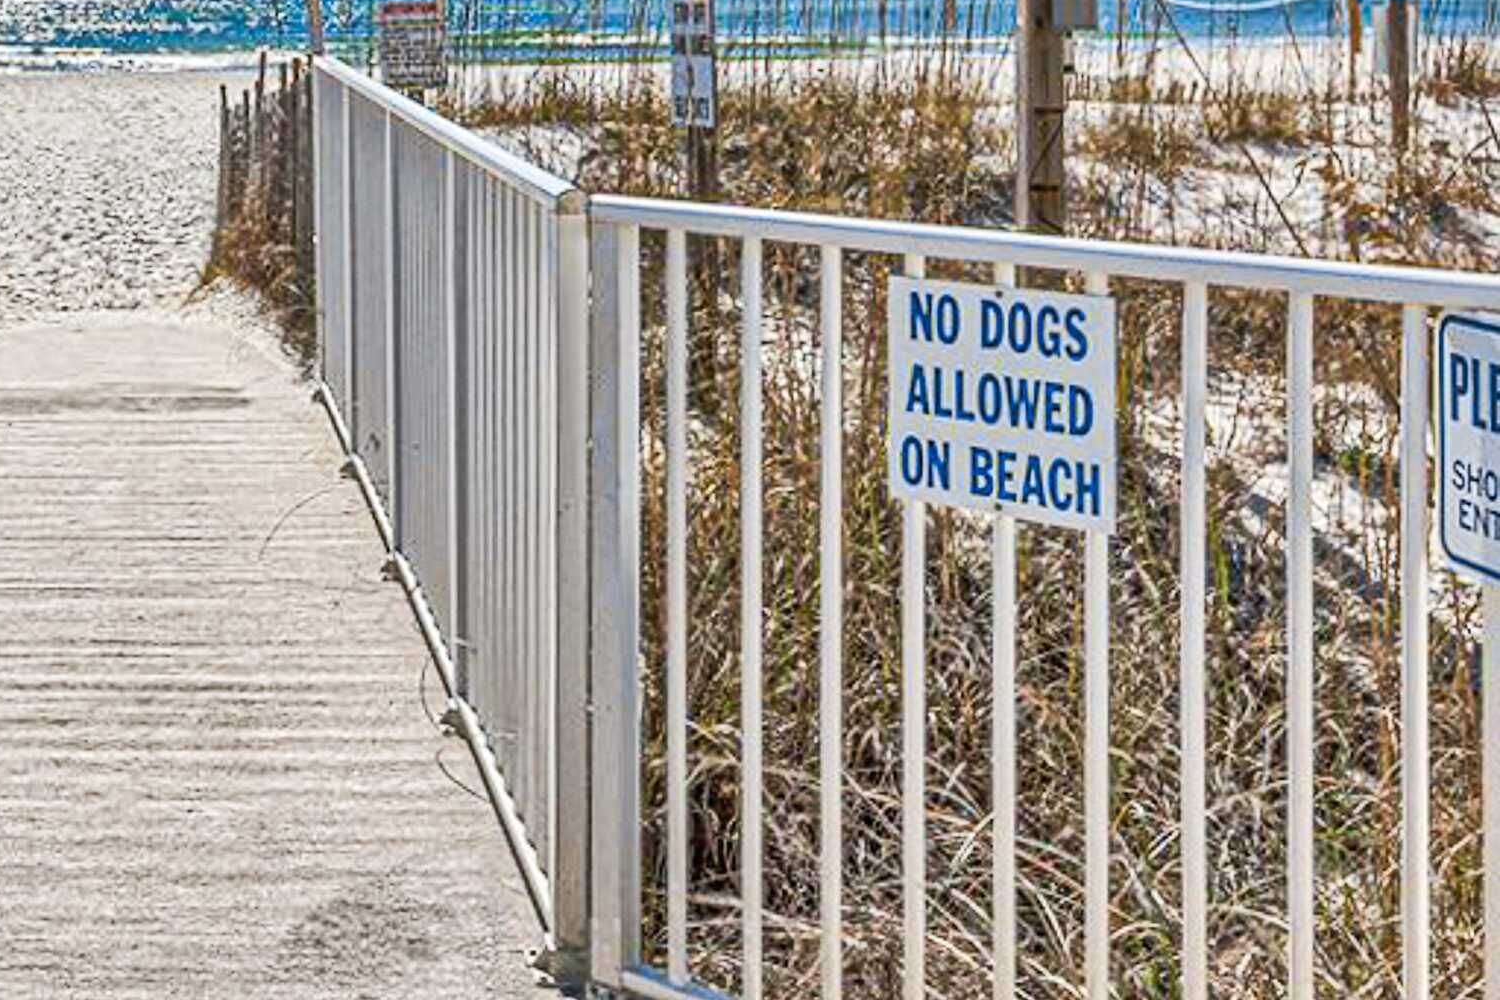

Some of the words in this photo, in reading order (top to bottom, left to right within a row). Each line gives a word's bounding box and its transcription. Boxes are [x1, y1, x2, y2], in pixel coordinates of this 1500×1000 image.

[909, 291, 960, 345] NO
[980, 298, 1088, 362] DOGS
[905, 362, 1094, 437] ALLOWED
[901, 434, 950, 491] ON
[969, 446, 1100, 517] BEACH
